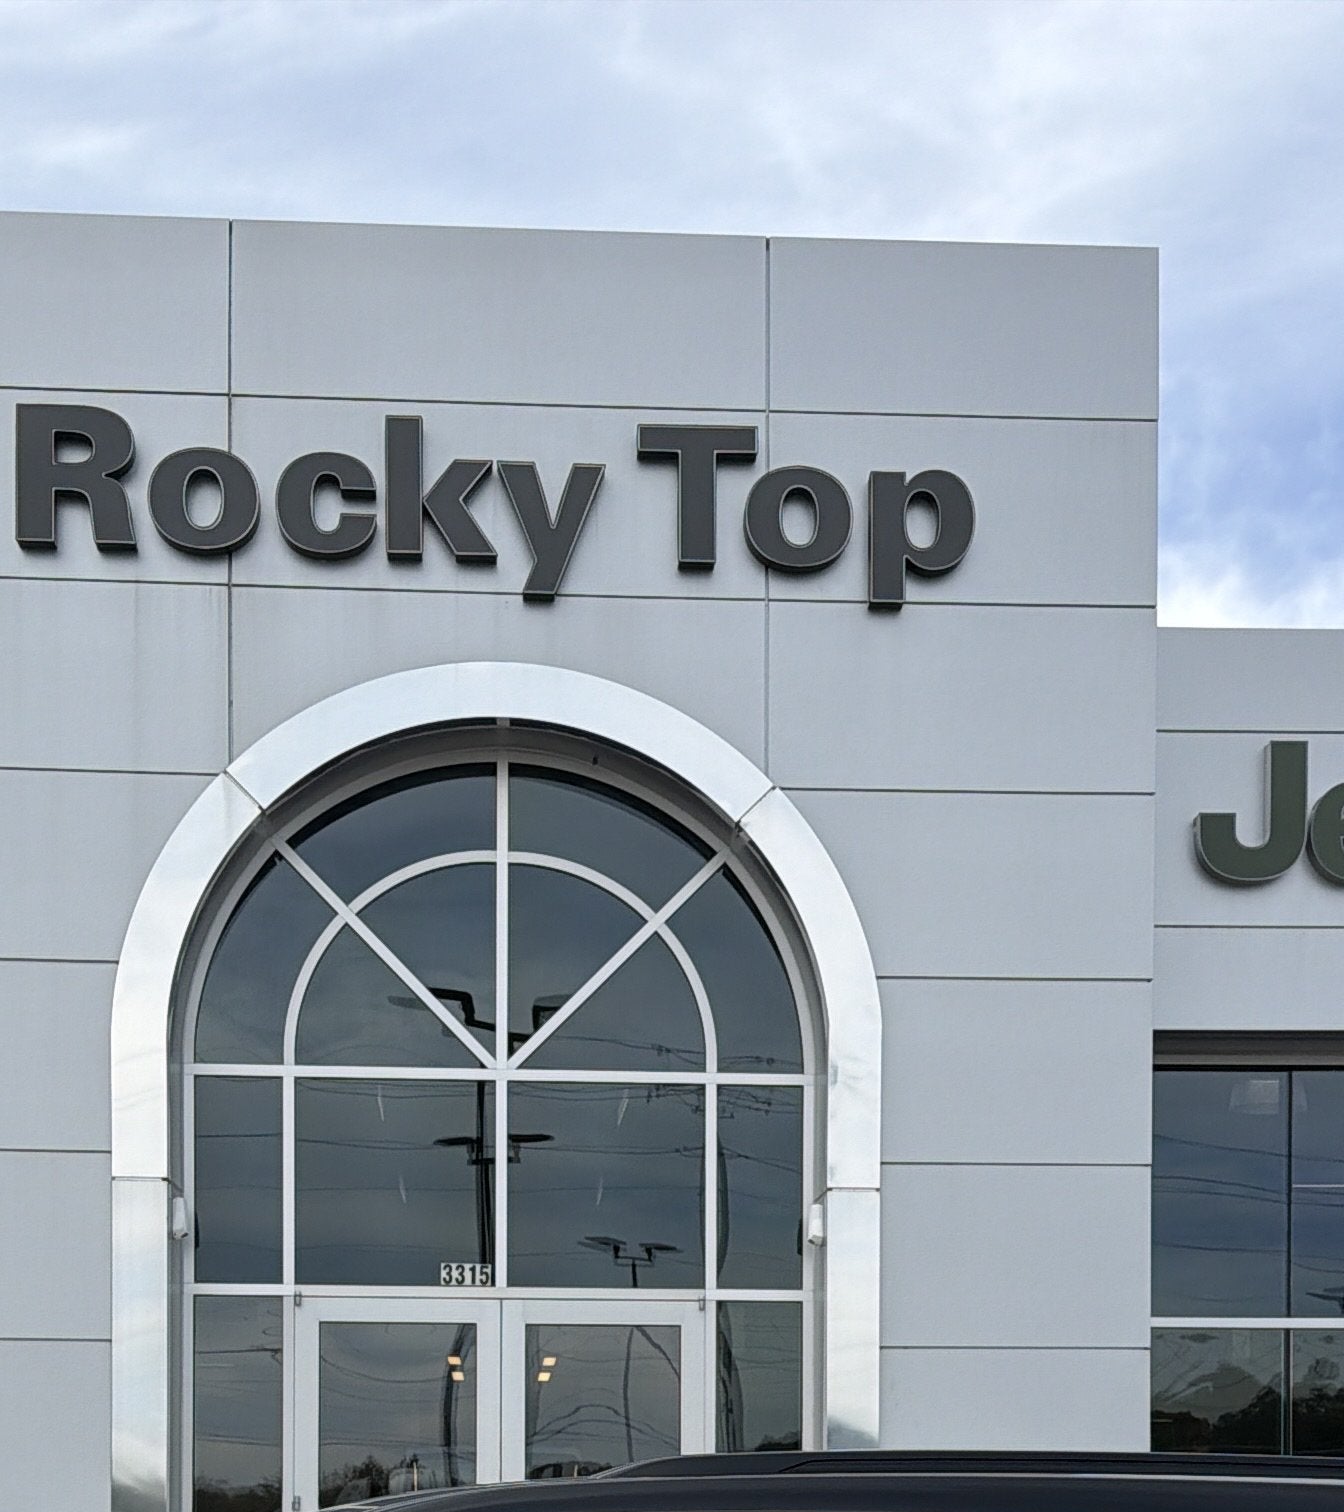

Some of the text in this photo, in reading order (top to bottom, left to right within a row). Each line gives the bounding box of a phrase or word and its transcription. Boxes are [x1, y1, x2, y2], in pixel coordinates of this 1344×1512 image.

[14, 402, 977, 610] Rocky Top
[442, 1263, 490, 1286] 3315
